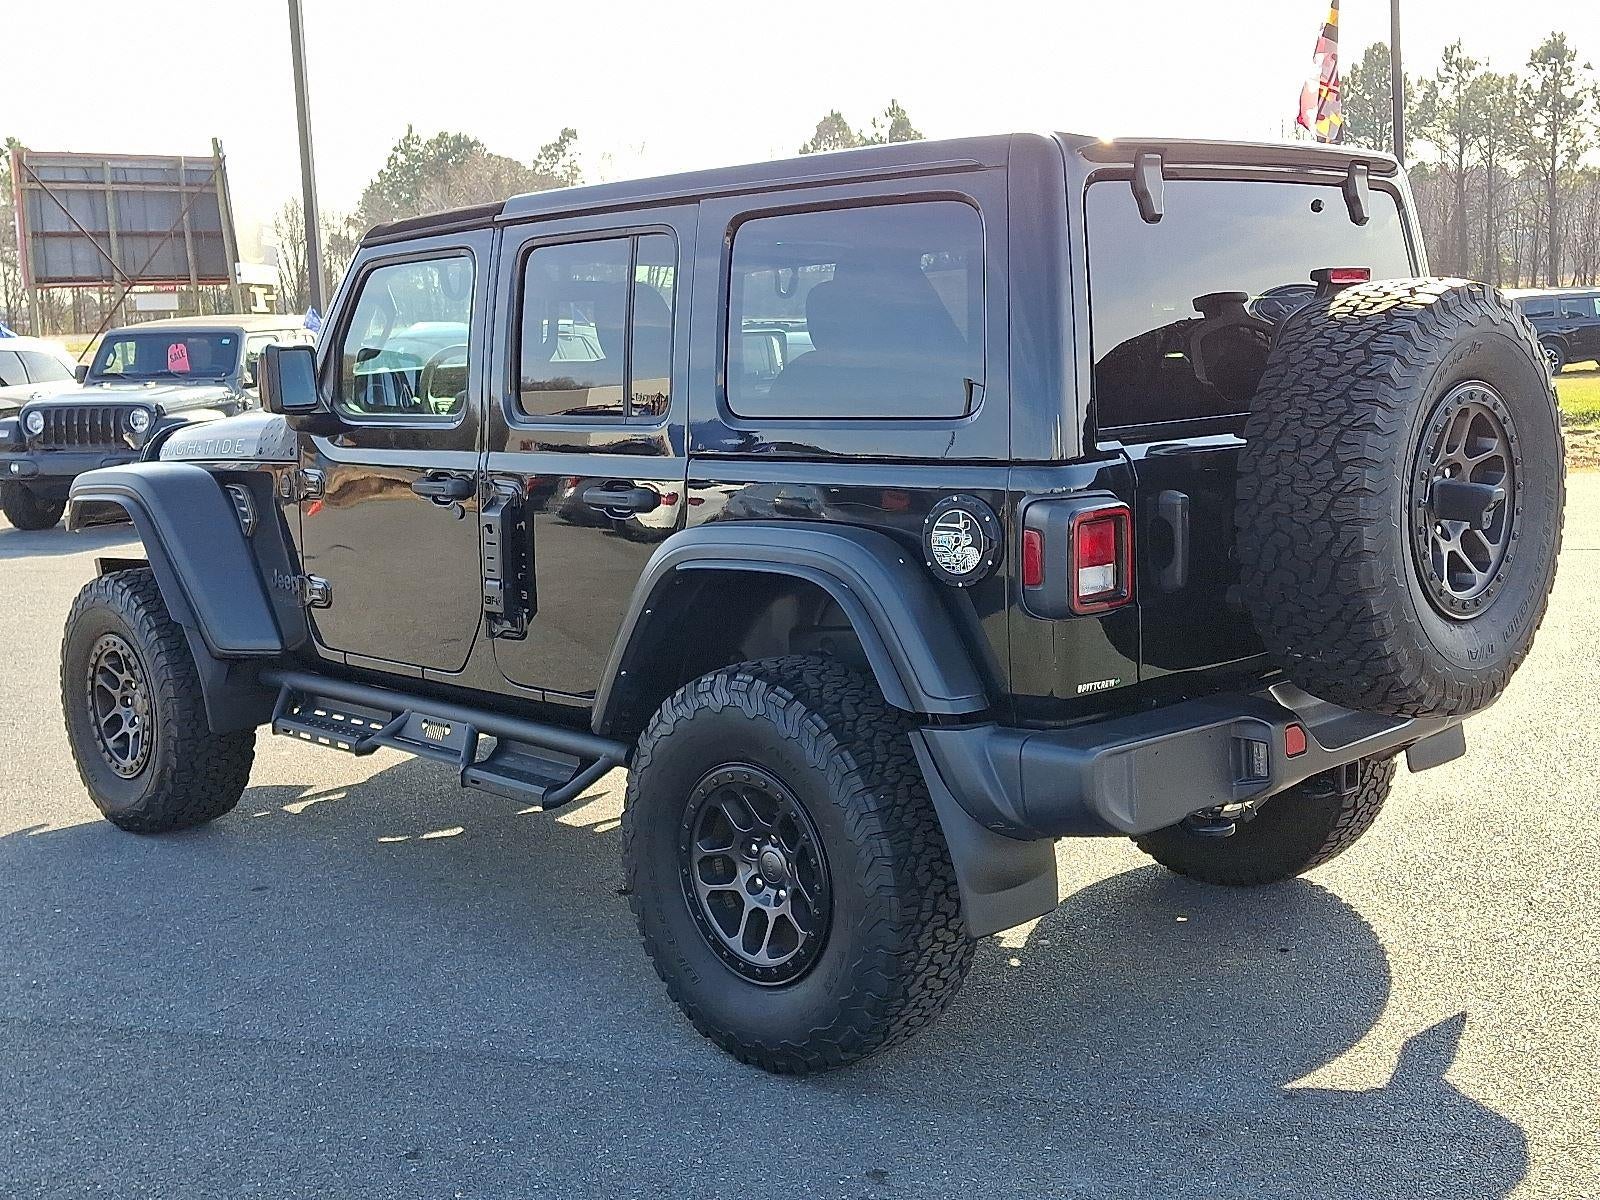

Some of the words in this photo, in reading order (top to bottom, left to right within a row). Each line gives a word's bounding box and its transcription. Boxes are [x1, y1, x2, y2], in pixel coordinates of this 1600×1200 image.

[169, 350, 187, 363] SALE
[204, 438, 246, 455] TIDE
[272, 569, 299, 595] Jeep
